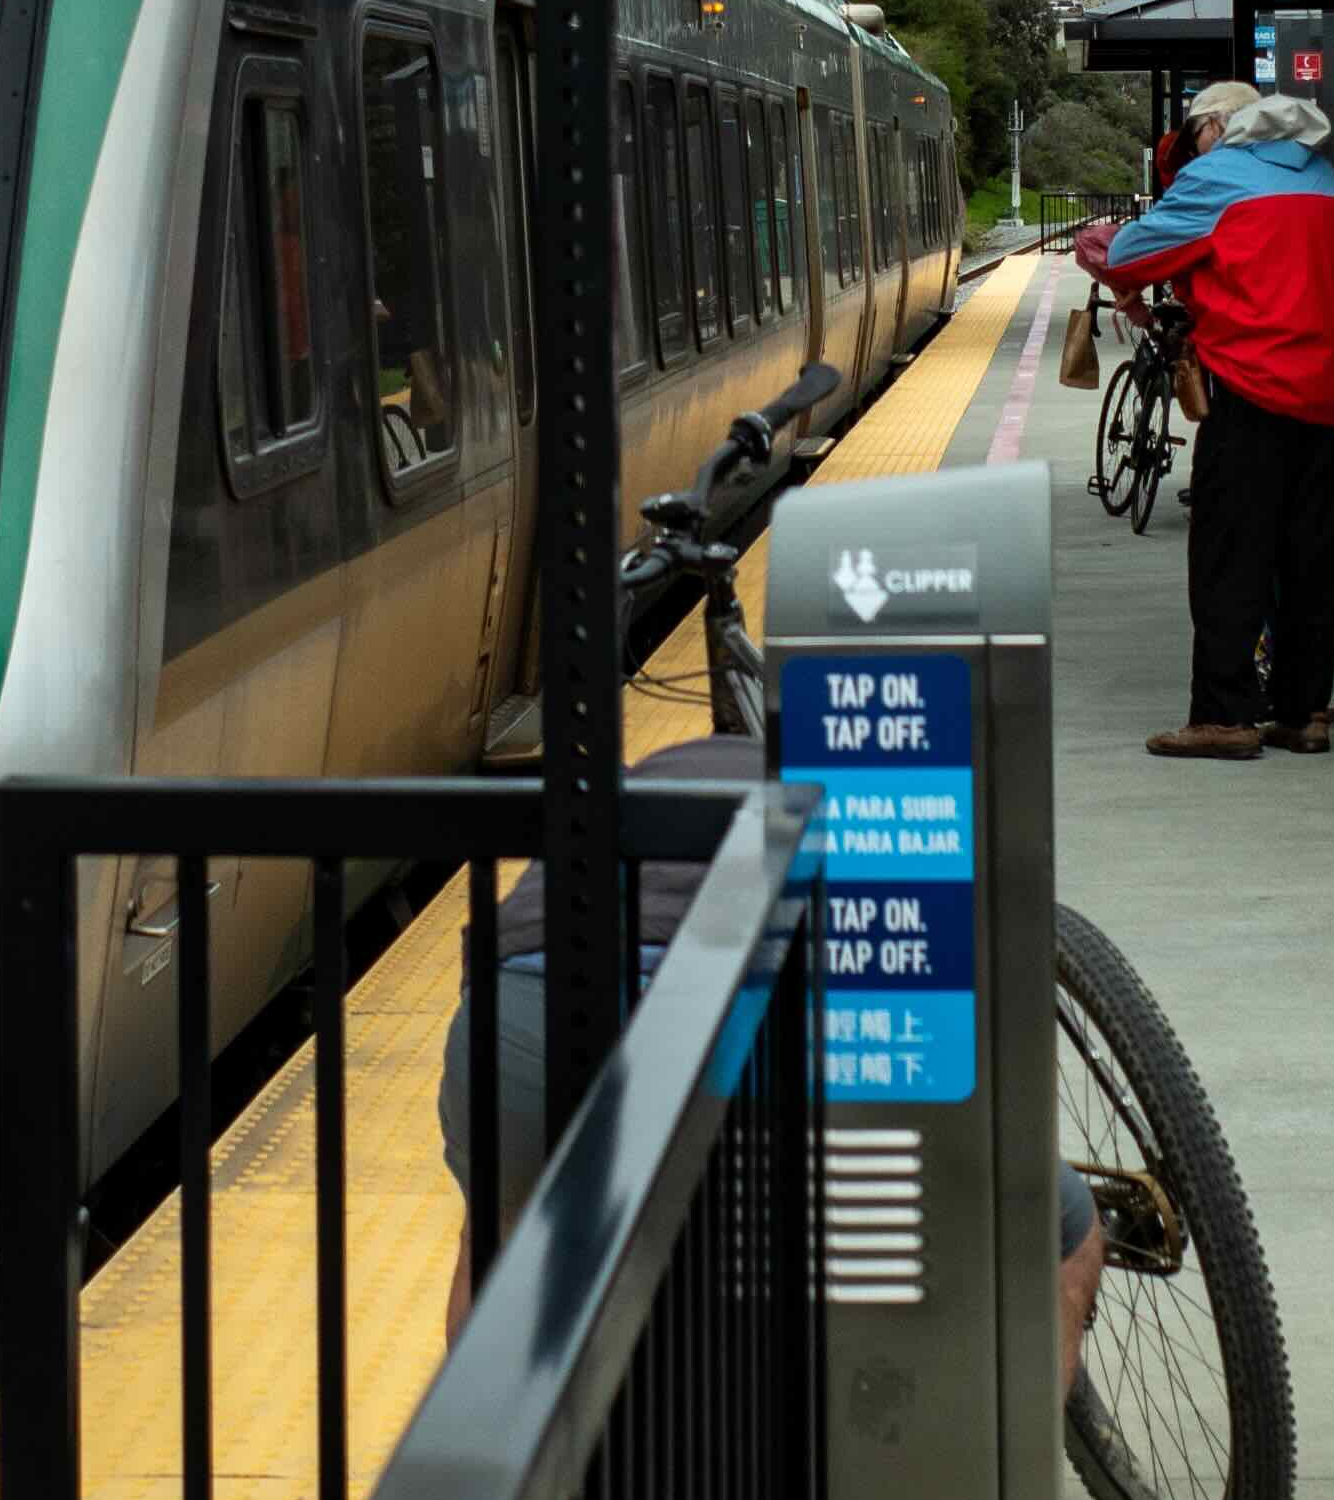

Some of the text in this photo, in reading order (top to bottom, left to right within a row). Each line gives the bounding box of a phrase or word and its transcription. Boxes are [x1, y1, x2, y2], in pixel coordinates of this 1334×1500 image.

[885, 567, 973, 593] CLIPPER
[826, 673, 925, 709] TAP ON.
[822, 715, 931, 751] TAP OFF.
[845, 795, 895, 821] PARA
[842, 829, 893, 855] PARA
[830, 896, 927, 934] TAP ON.
[826, 940, 932, 976] TAP OFF.
